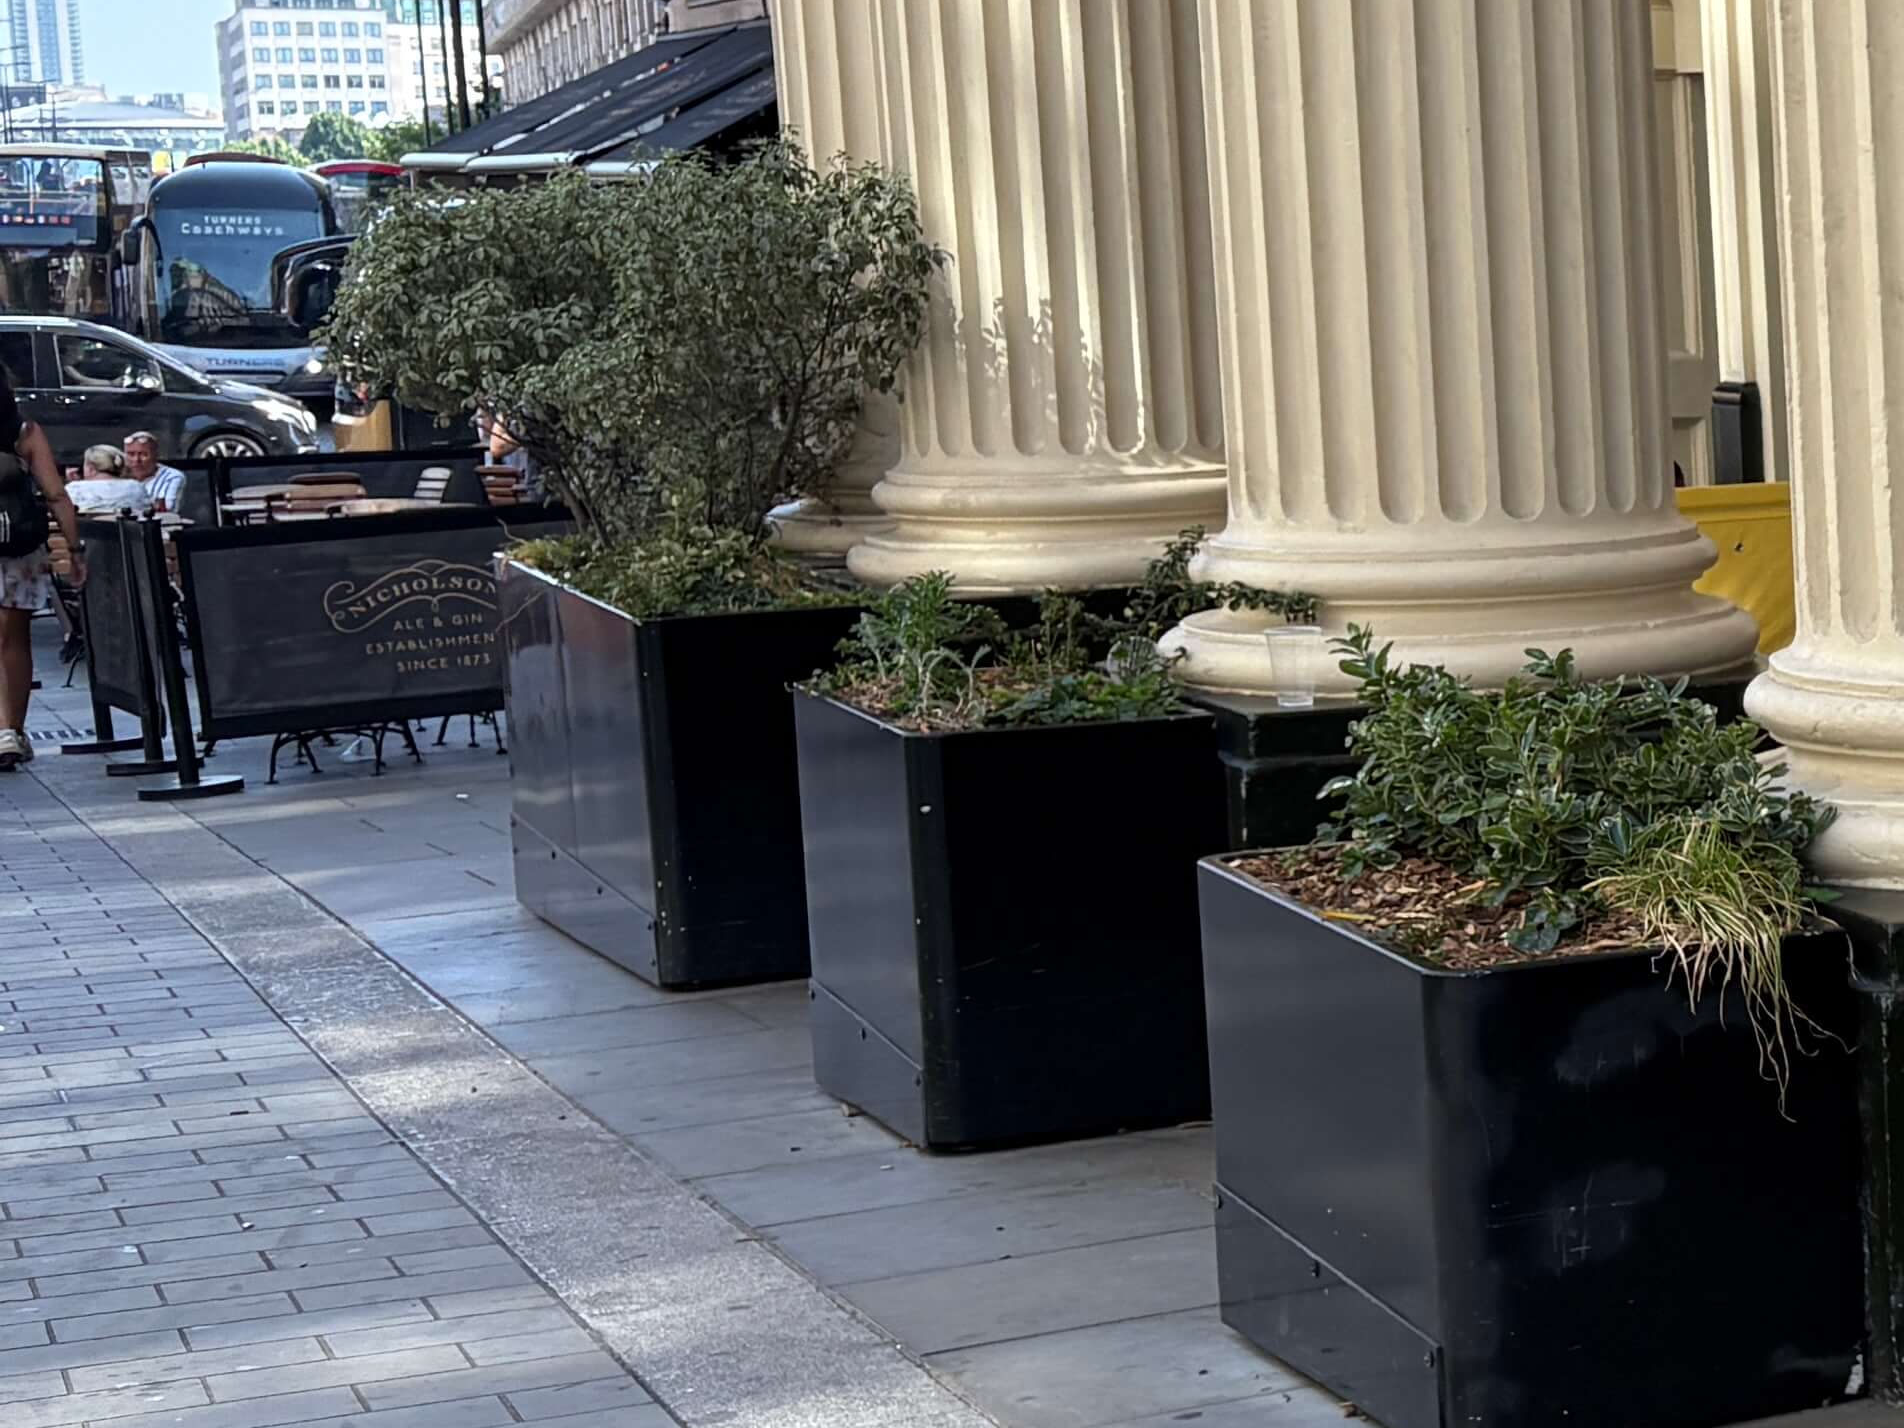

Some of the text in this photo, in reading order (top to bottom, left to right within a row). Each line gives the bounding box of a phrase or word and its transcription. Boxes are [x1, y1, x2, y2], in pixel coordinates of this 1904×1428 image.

[393, 613, 484, 632] ALE & GIN
[397, 652, 492, 673] SINCE 1873
